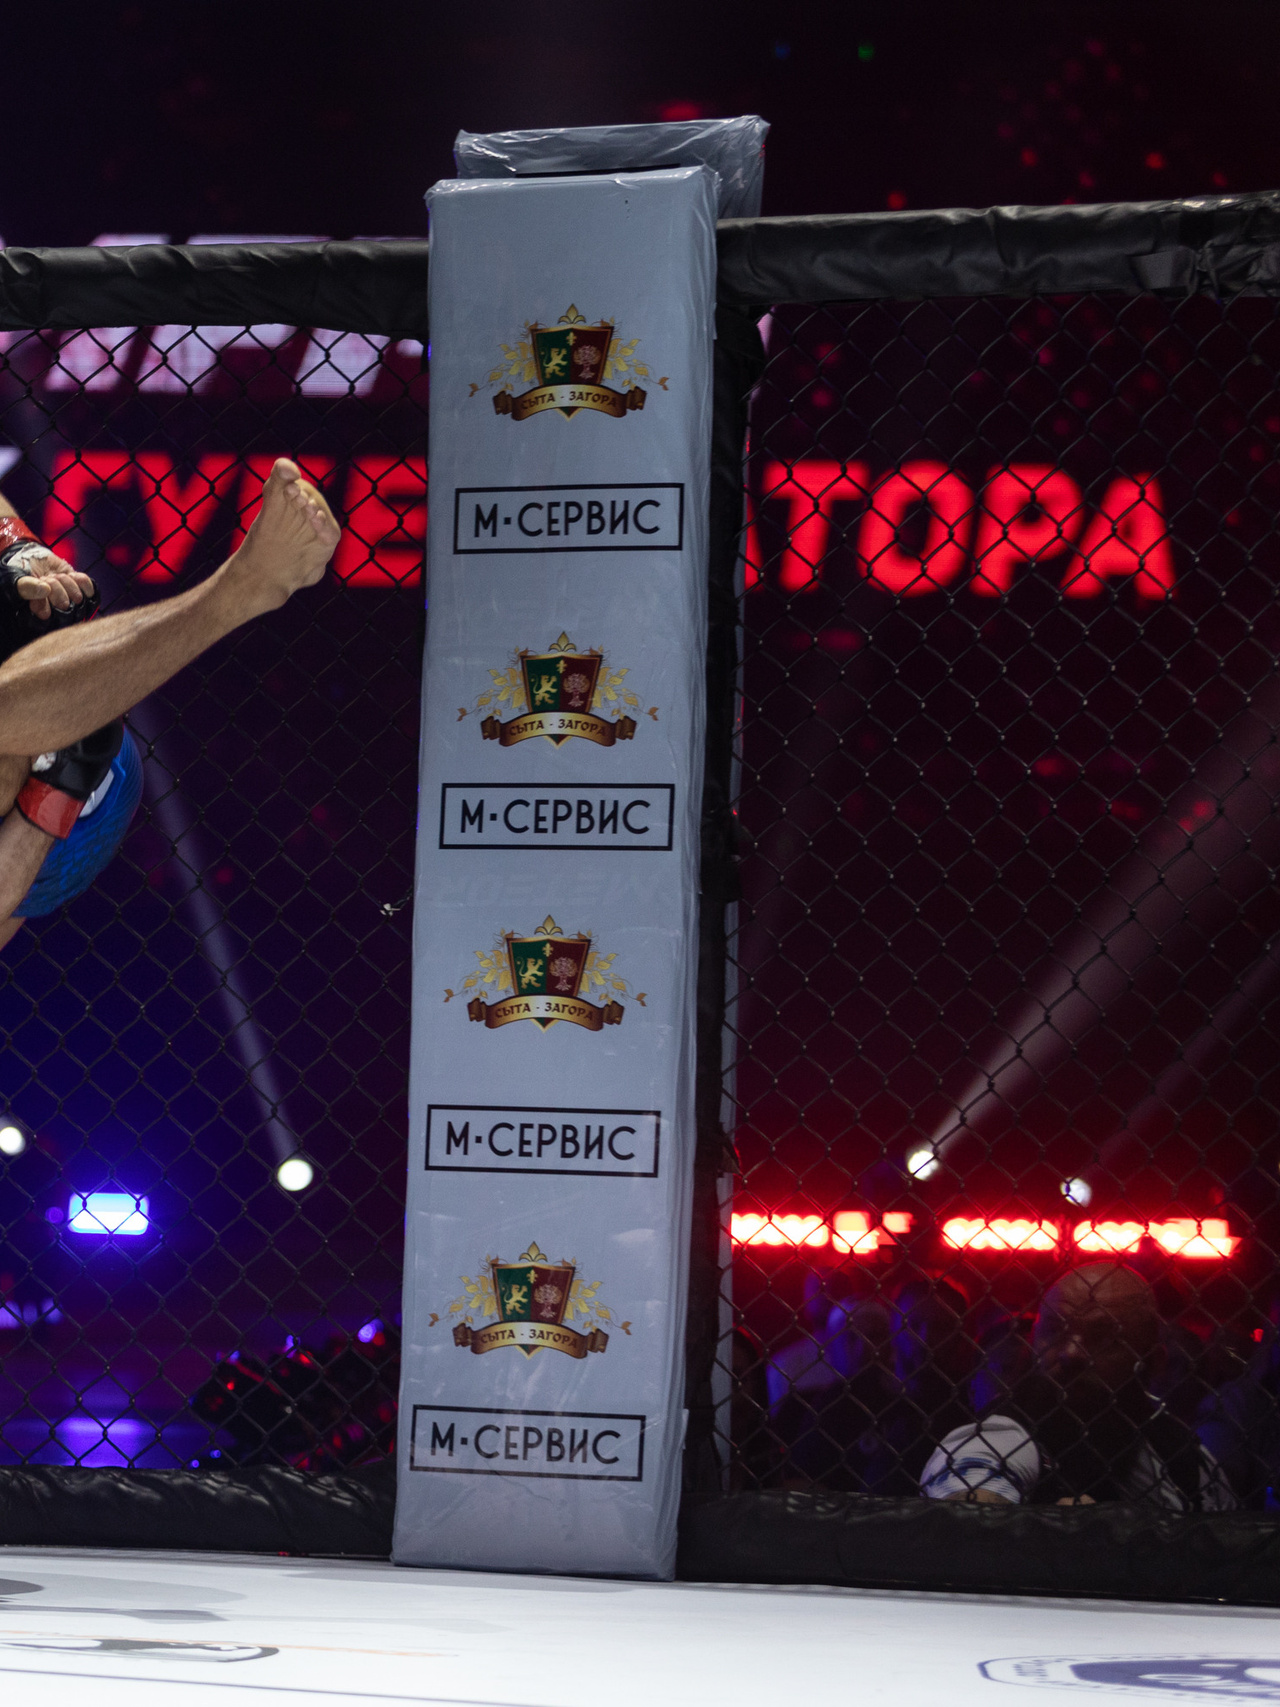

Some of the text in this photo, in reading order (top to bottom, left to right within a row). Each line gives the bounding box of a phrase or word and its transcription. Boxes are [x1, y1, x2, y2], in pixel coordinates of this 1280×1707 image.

[520, 392, 556, 410] СЫТА
[568, 391, 618, 408] ЗАГОРА
[508, 719, 545, 737] СЫТА
[557, 718, 607, 737] ЗАГОРА
[494, 1003, 531, 1019] СЫТА
[544, 1002, 594, 1021] ЗАГОРА
[480, 1329, 516, 1344] СЫТА
[528, 1328, 578, 1349] ЗАГОРА
